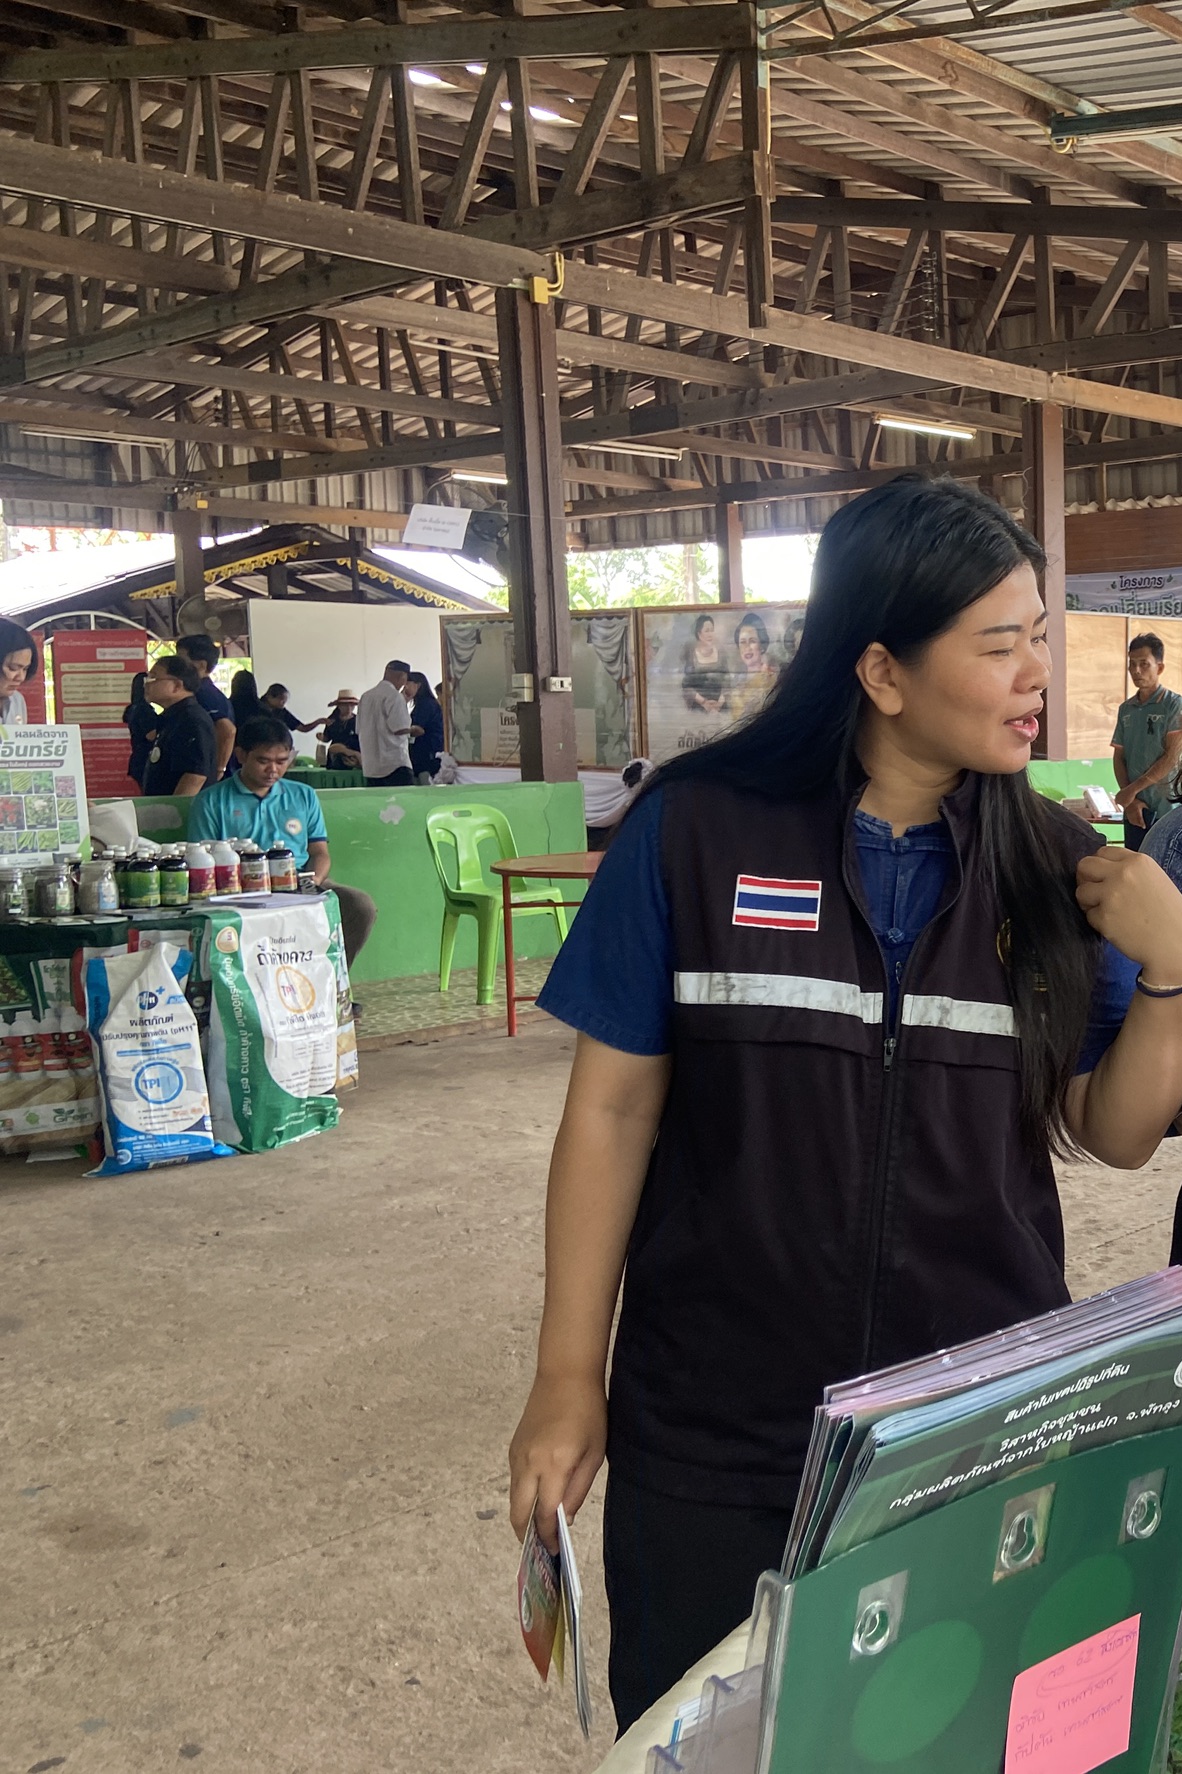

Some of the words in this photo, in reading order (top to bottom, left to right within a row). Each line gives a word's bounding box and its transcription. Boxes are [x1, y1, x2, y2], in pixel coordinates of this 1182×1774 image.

[1119, 575, 1164, 590] โครงการ
[15, 729, 68, 738] ผลผลิตจาก
[129, 1013, 174, 1027] ผลิตภัณฑ์
[142, 1077, 160, 1089] TPI
[1004, 1364, 1130, 1424] สินค้าในเขตปฏิรูปที่ดิน
[1000, 1401, 1101, 1452] วิสาหกิจชุมชน
[889, 1415, 1118, 1510] กลุ่มผลิตภัณฑ์จากใบหญ้าแฝก
[1126, 1398, 1181, 1422] จ.พัทลุง
